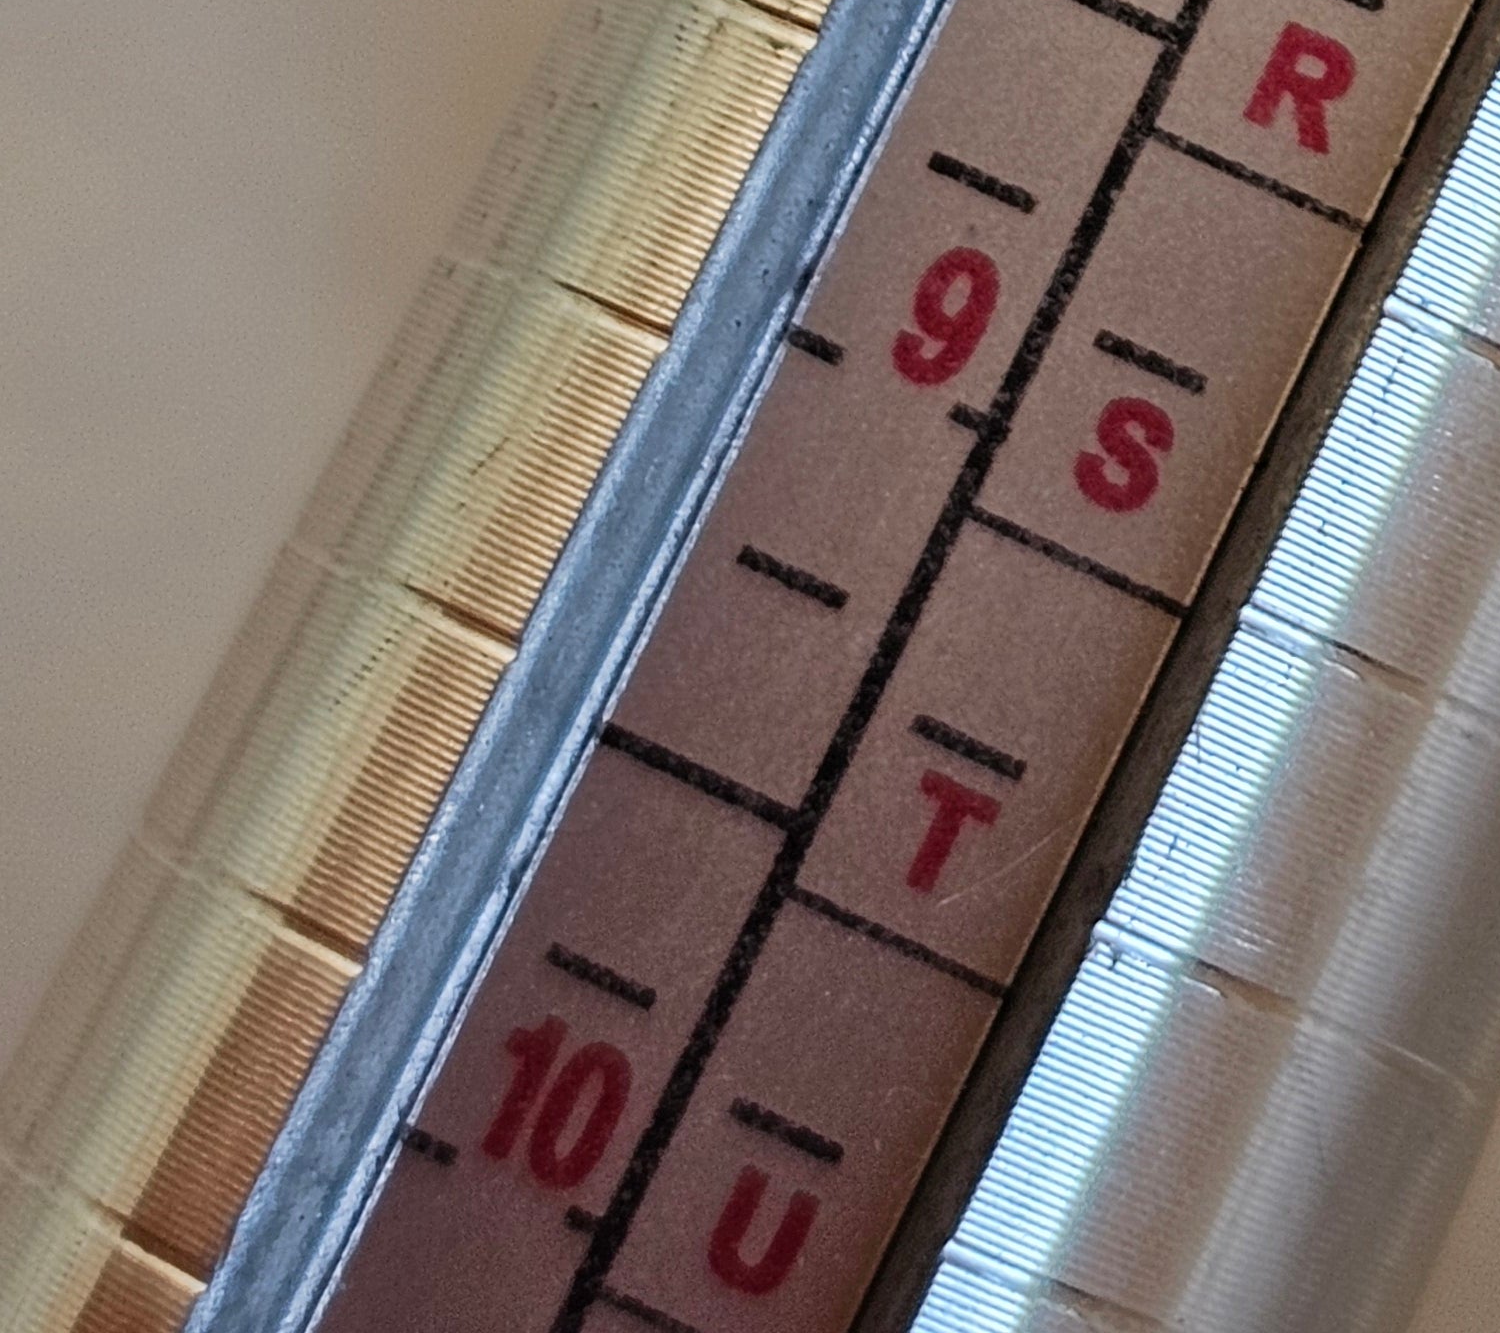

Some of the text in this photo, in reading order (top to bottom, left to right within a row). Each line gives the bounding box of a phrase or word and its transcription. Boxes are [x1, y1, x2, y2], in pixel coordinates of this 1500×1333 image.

[1243, 21, 1357, 156] R
[892, 247, 999, 386] 9
[1073, 397, 1175, 514] S
[905, 769, 1002, 896] T
[480, 1014, 634, 1191] 10
[705, 1167, 818, 1293] U
